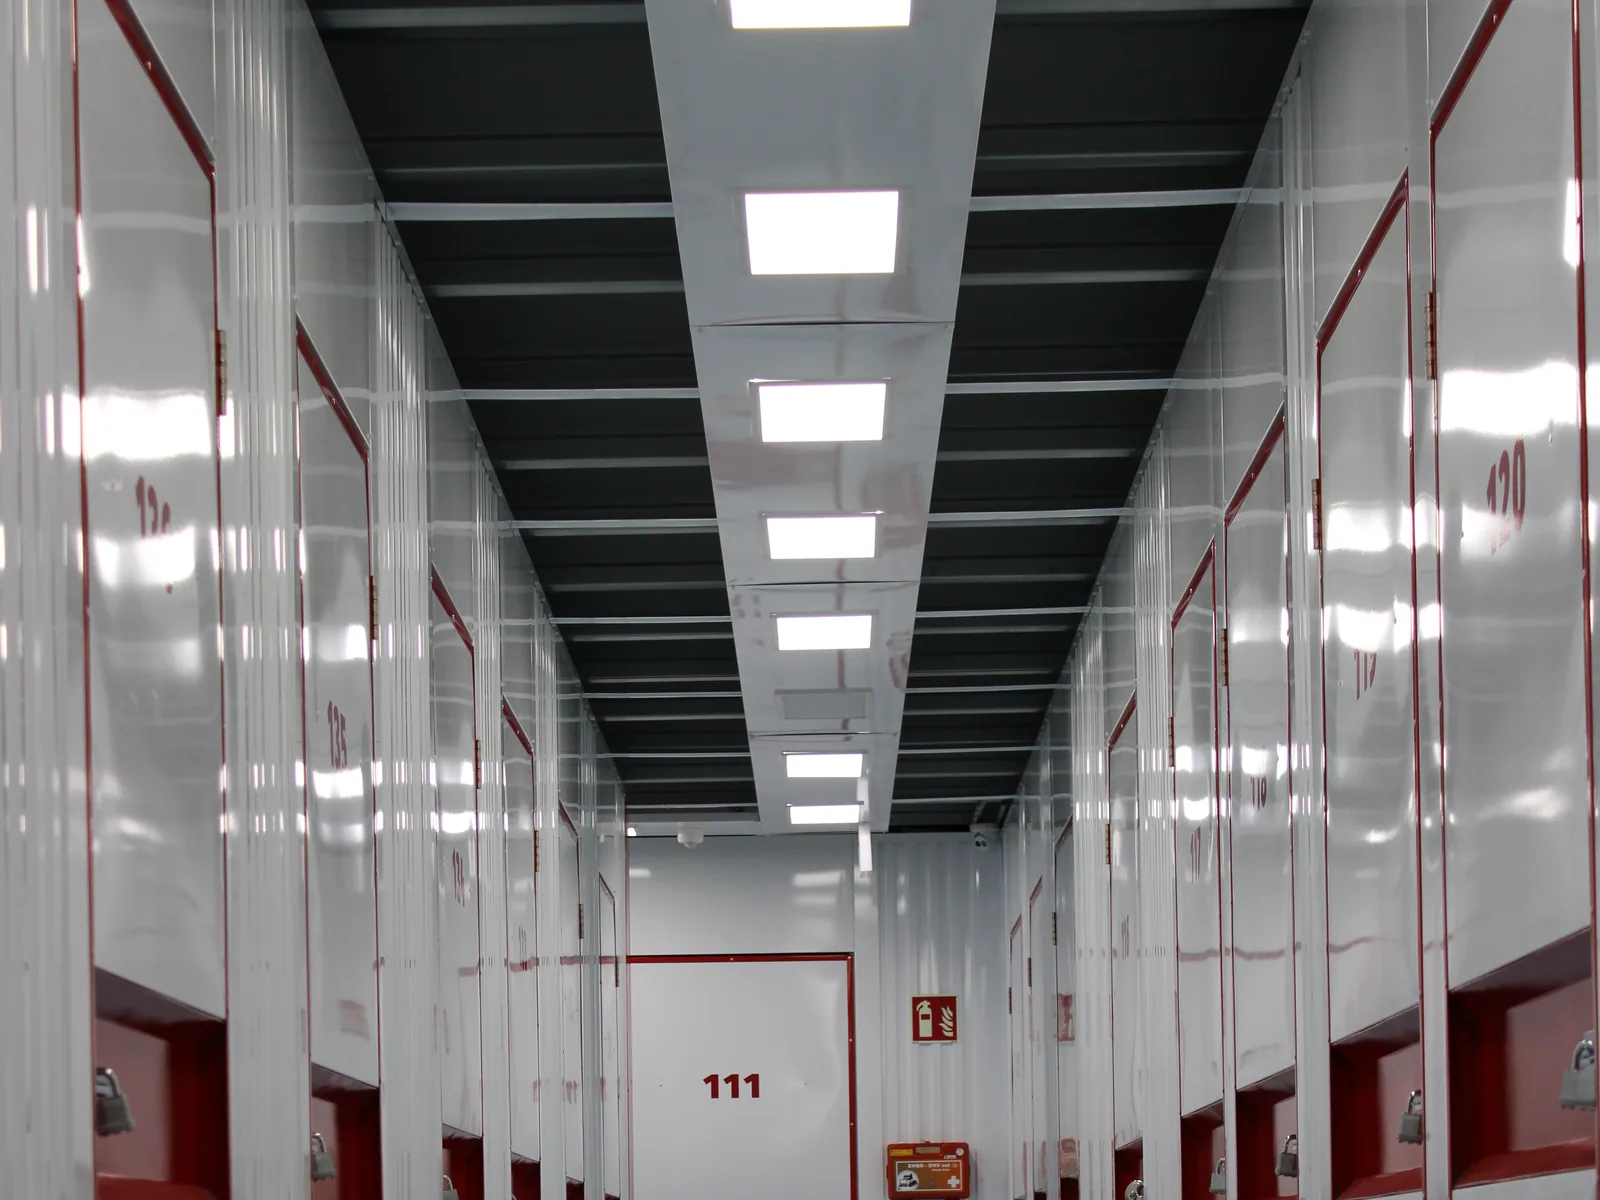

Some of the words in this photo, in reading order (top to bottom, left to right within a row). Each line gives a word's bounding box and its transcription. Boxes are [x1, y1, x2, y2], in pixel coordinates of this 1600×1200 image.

[1486, 438, 1527, 556] 120
[326, 700, 348, 770] 135
[702, 1073, 760, 1099] 111
